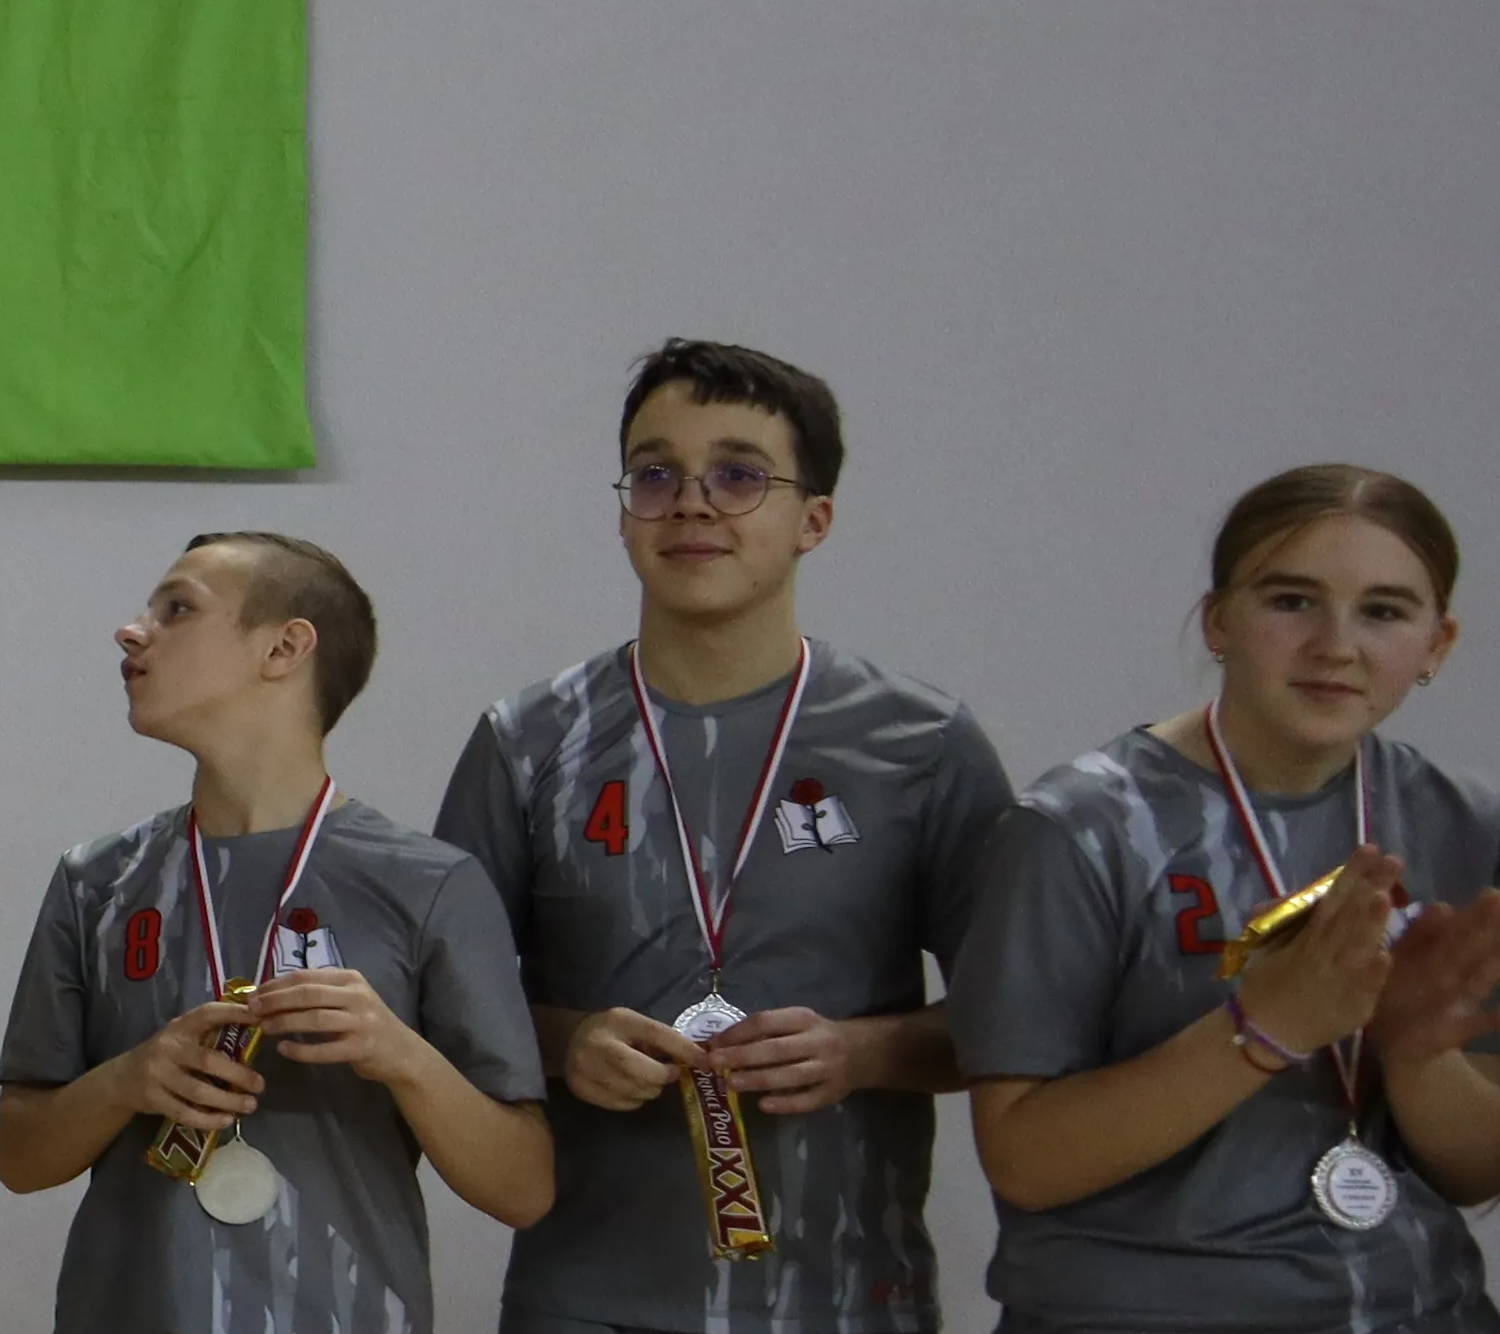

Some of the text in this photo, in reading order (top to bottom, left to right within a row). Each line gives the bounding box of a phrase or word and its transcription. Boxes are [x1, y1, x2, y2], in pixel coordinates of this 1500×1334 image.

[583, 779, 629, 857] 4
[123, 907, 162, 982] 8
[1167, 873, 1225, 956] 2
[706, 1146, 767, 1249] XXL
